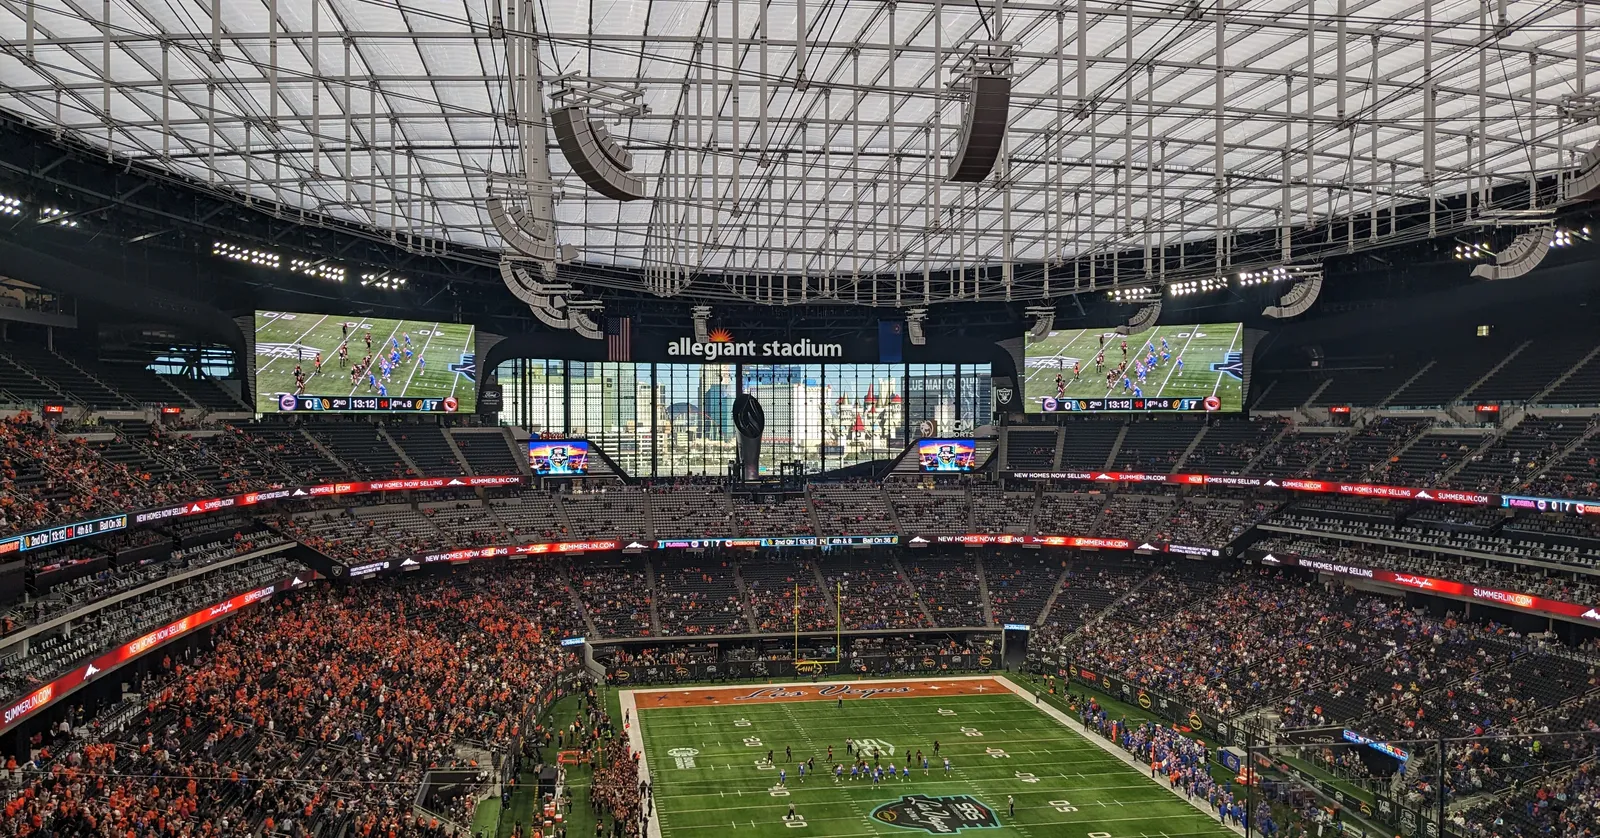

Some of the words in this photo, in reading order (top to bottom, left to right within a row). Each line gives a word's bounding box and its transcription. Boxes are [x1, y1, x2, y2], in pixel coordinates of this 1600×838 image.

[668, 337, 756, 360] allegiant
[762, 338, 842, 357] stadium
[305, 401, 313, 409] 0
[333, 399, 347, 408] 2ND
[353, 400, 375, 408] 13:12
[380, 400, 389, 408] 14
[431, 401, 438, 410] 7
[1064, 402, 1071, 410] 0
[1090, 401, 1103, 409] 2ND
[1108, 401, 1130, 409] 13:12
[1190, 401, 1197, 409] 7
[276, 490, 290, 498] SELLING
[1438, 493, 1488, 502] SUMMERLIN.COM
[204, 498, 234, 510] SUMMERLIN.COM
[1551, 501, 1557, 509] 0
[1565, 502, 1570, 511] 7
[136, 514, 147, 523] NEW
[147, 511, 161, 520] HOMES
[172, 506, 188, 516] SELLING
[100, 520, 109, 531] Ball
[109, 519, 116, 528] On
[31, 537, 41, 546] 2nd
[41, 534, 49, 544] Qtr
[1075, 539, 1128, 547] SUMMERLIN.COM
[559, 543, 615, 551] SUMMERLIN.COM
[481, 548, 508, 557] SELLING
[1299, 559, 1313, 567] NEW
[1313, 561, 1333, 570] HOMES
[1334, 564, 1349, 573] NOW
[1349, 567, 1373, 578] SELLING
[244, 585, 275, 603] SUMMERLIN.COM
[1473, 587, 1533, 606] SUMMERLIN.COM
[129, 641, 141, 654] NEW
[140, 633, 157, 648] HOMES
[157, 628, 169, 640] NOW
[169, 621, 187, 636] SELLING
[734, 687, 808, 701] Las
[818, 684, 914, 699] Vegas
[4, 687, 53, 724] SUMMERLIN.COM
[1048, 800, 1078, 813] 50
[782, 814, 807, 828] 50
